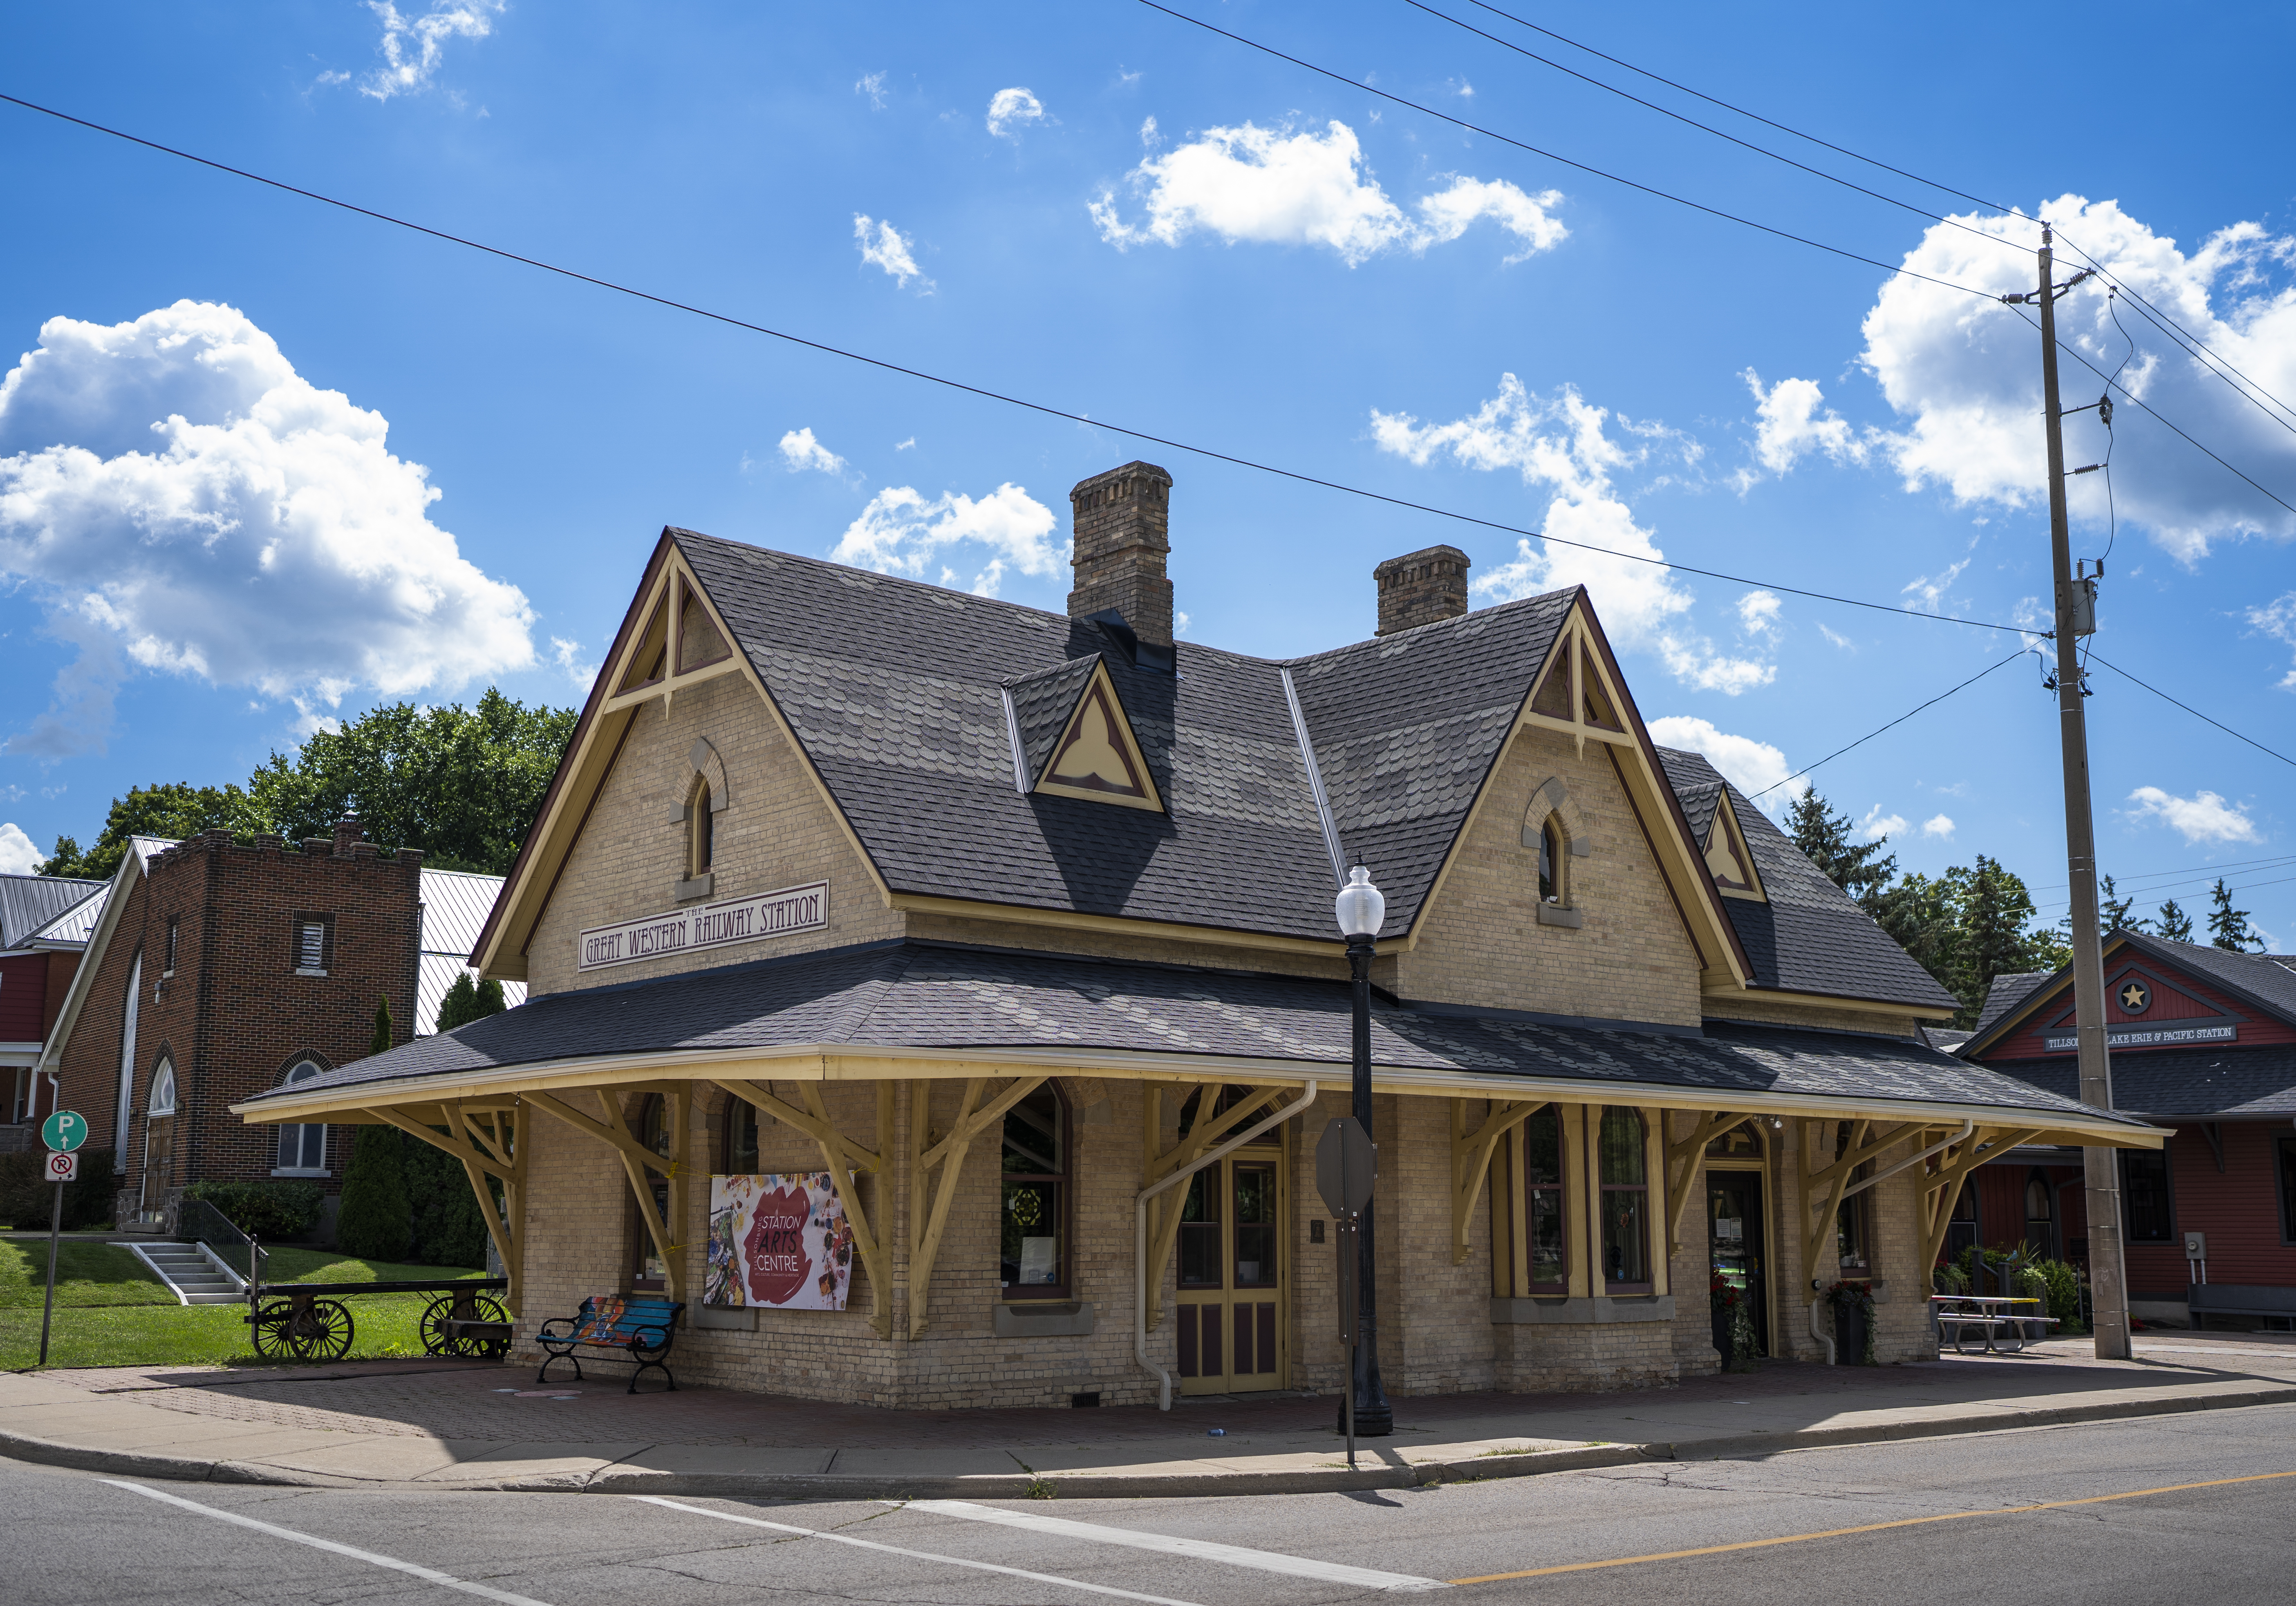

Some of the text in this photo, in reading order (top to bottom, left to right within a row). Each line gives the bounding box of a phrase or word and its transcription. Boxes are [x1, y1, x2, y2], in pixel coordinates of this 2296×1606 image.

[686, 907, 703, 917] THE
[586, 894, 819, 963] GREAT WESTERN RAILWAY STATION
[2131, 1033, 2152, 1042] ERIE
[2154, 1033, 2161, 1041] &
[2163, 1030, 2194, 1040] PACIFIC
[2197, 1027, 2232, 1038] STATION
[58, 1116, 74, 1133] P
[762, 1216, 801, 1229] STATION
[753, 1216, 763, 1270] TILLSONBURG
[757, 1230, 797, 1253] ARTS
[757, 1255, 798, 1271] CENTRE
